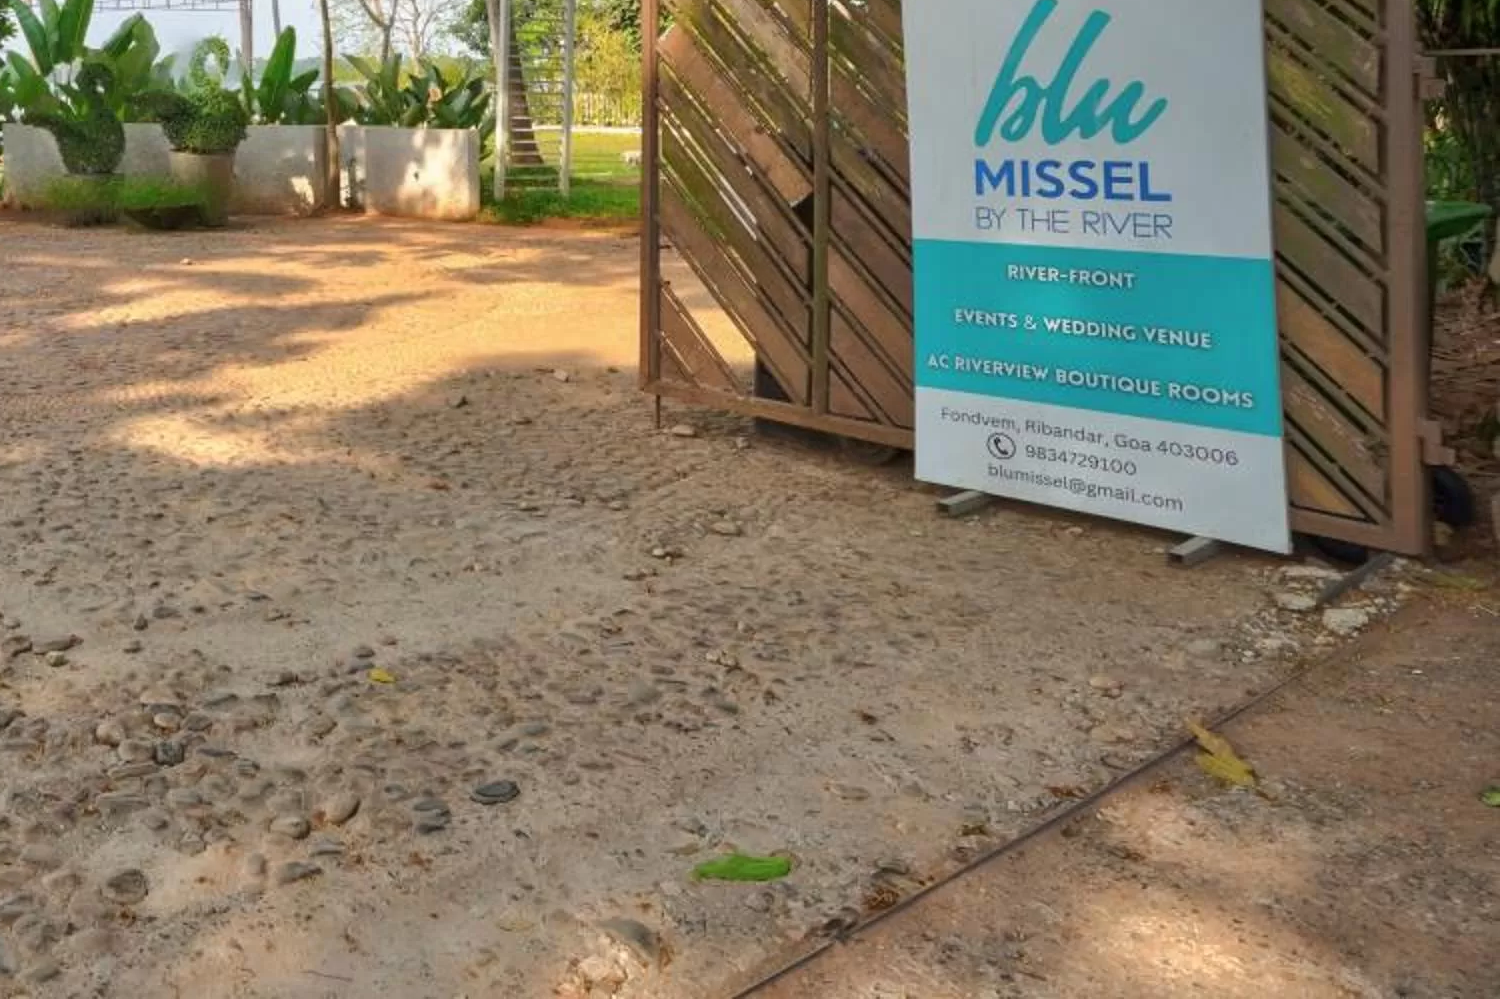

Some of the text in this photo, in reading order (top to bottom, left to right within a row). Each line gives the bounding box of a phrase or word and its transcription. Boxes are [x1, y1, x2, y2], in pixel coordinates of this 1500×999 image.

[974, 159, 1173, 202] MISSEL
[975, 206, 1174, 239] BY THE RIVER
[1007, 264, 1136, 289] RIVER-FRONT
[954, 308, 1213, 349] EVENTS & WEDDING VENUE
[927, 354, 1254, 409] AC RIVERVIEW BOUTIQUE ROOMS
[940, 407, 1239, 467] Fondvem, Ribandar, Goa 403006
[1025, 444, 1138, 477] 9834729100
[988, 463, 1184, 513] blumissel@gmail.com
